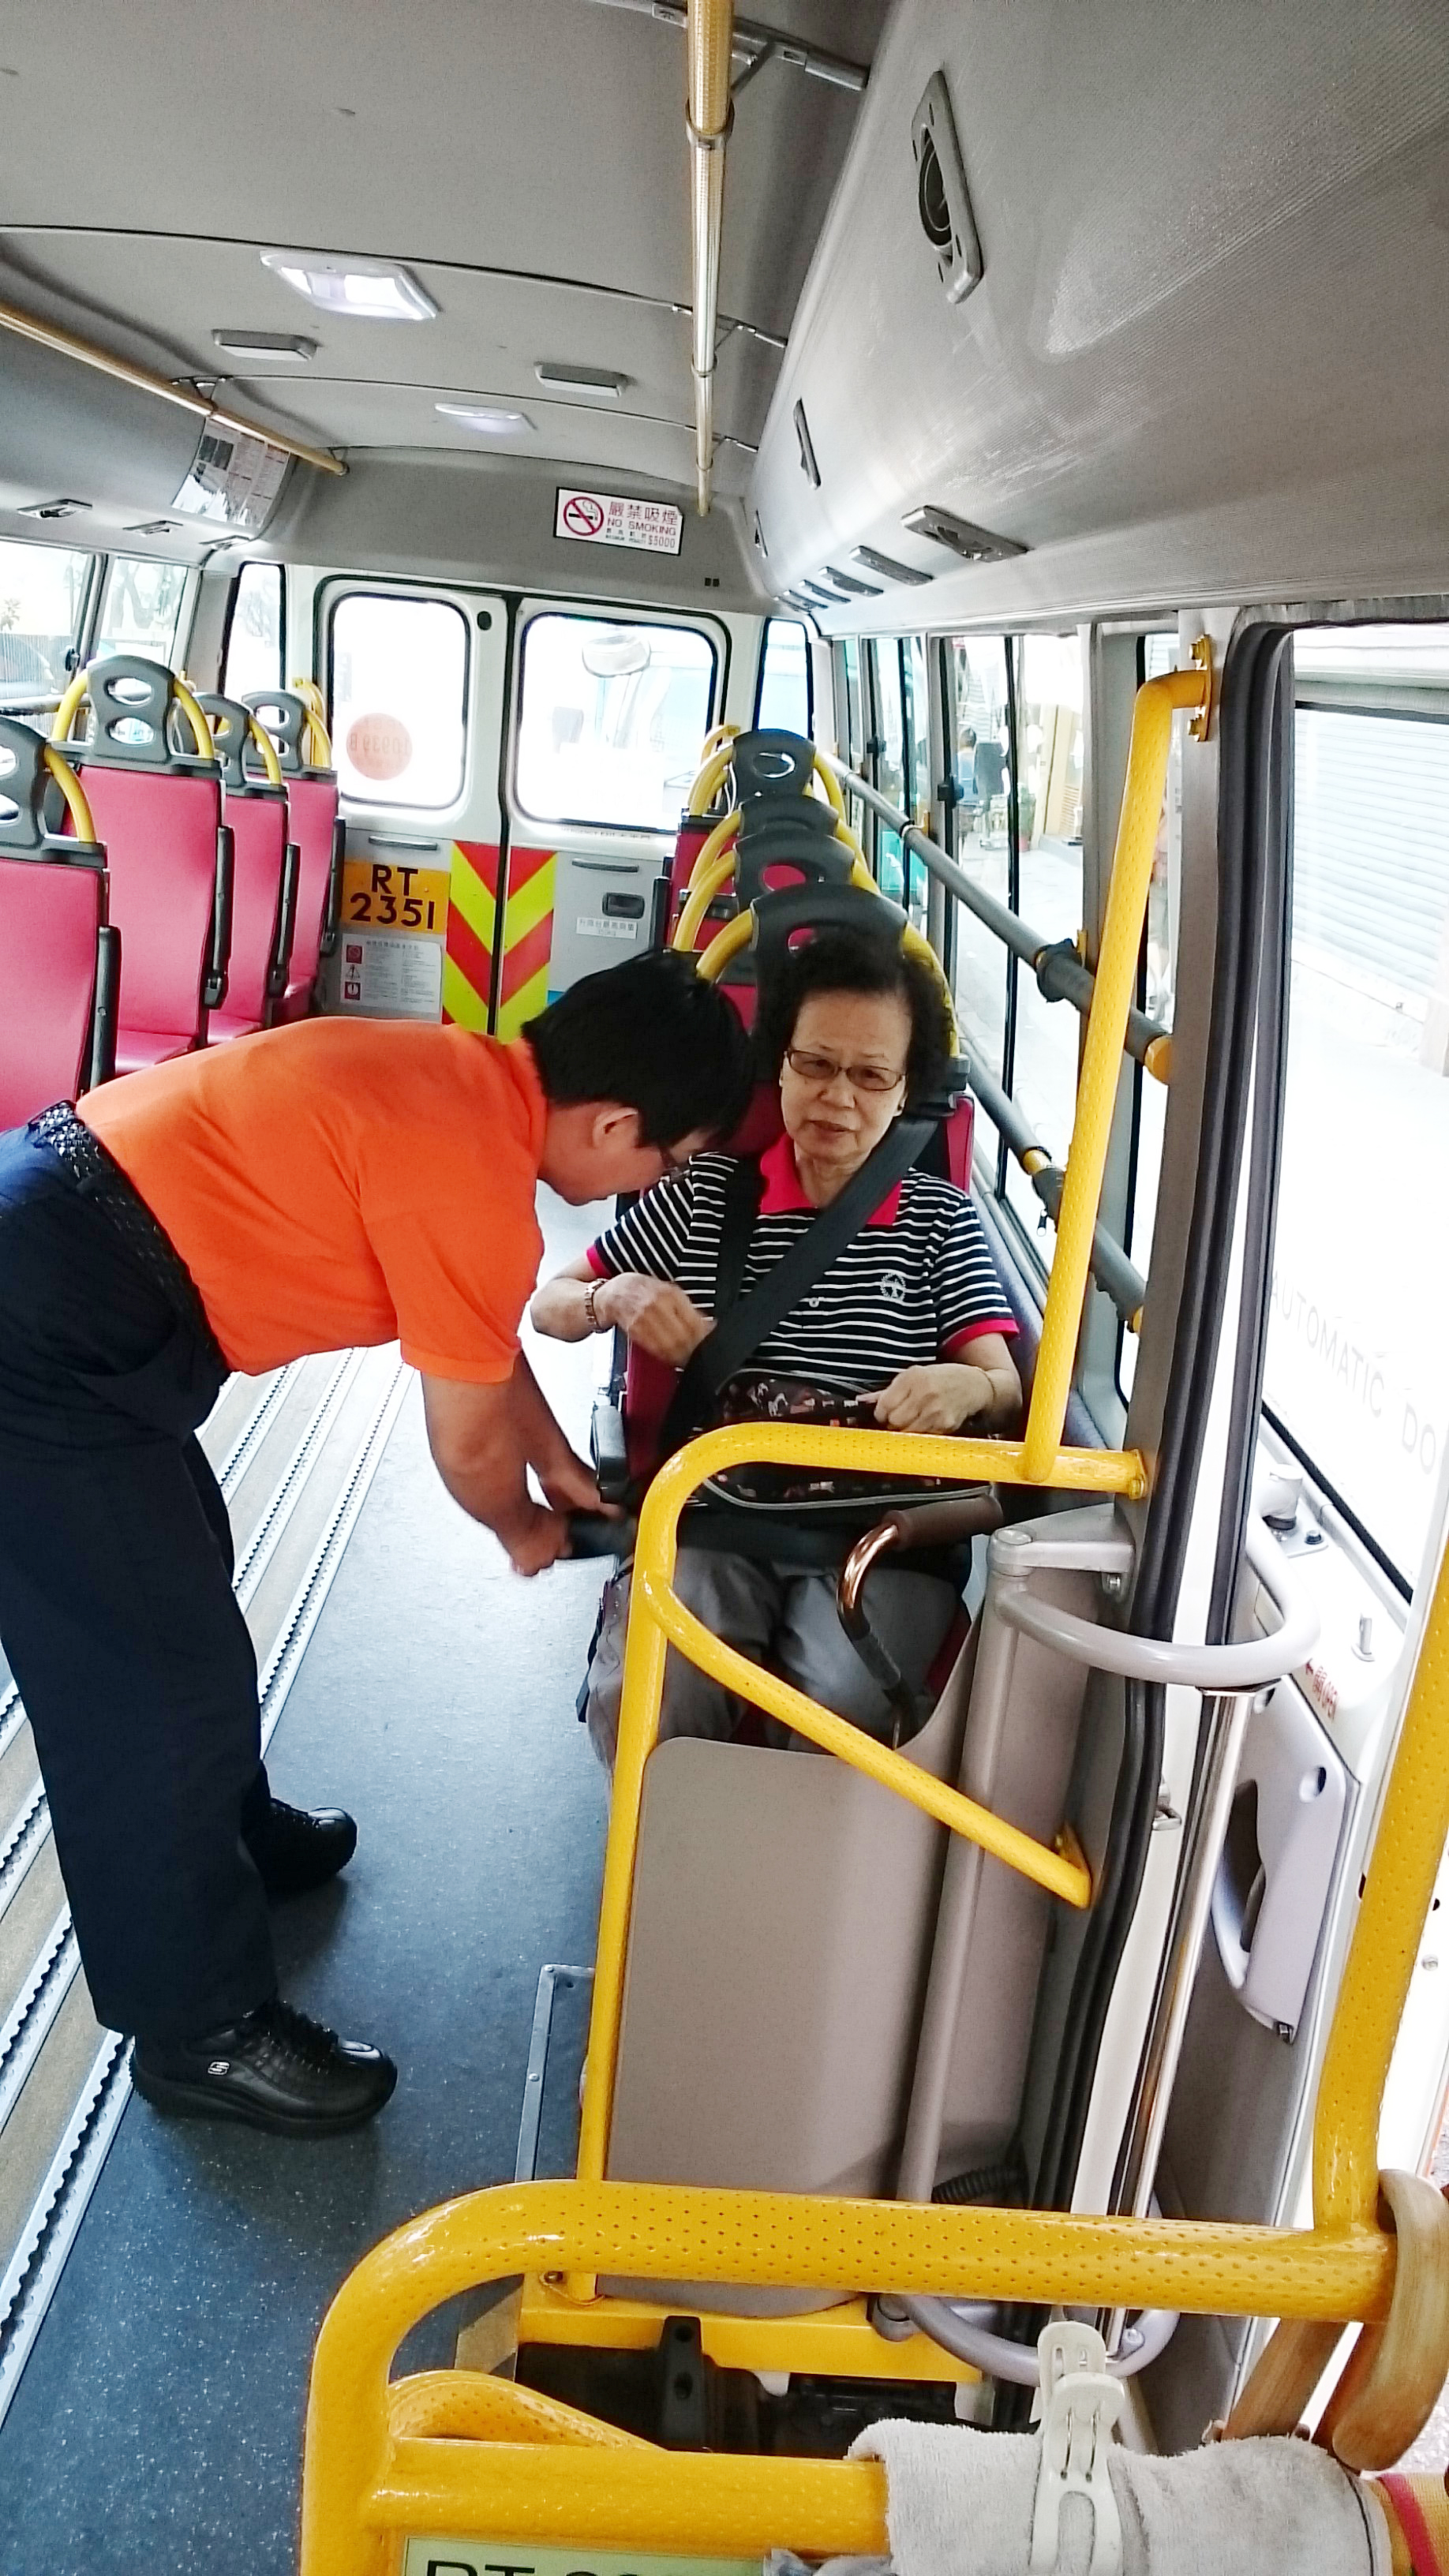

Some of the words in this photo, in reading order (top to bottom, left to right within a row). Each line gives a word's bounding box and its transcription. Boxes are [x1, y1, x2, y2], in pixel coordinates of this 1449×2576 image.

[607, 518, 623, 527] NO
[628, 521, 676, 537] SMOKING
[608, 501, 678, 526] 嚴禁吸煙
[648, 535, 676, 549] $5000
[372, 864, 418, 896] RT
[350, 892, 435, 930] 2351
[1271, 1269, 1385, 1419] AUTOMATIC
